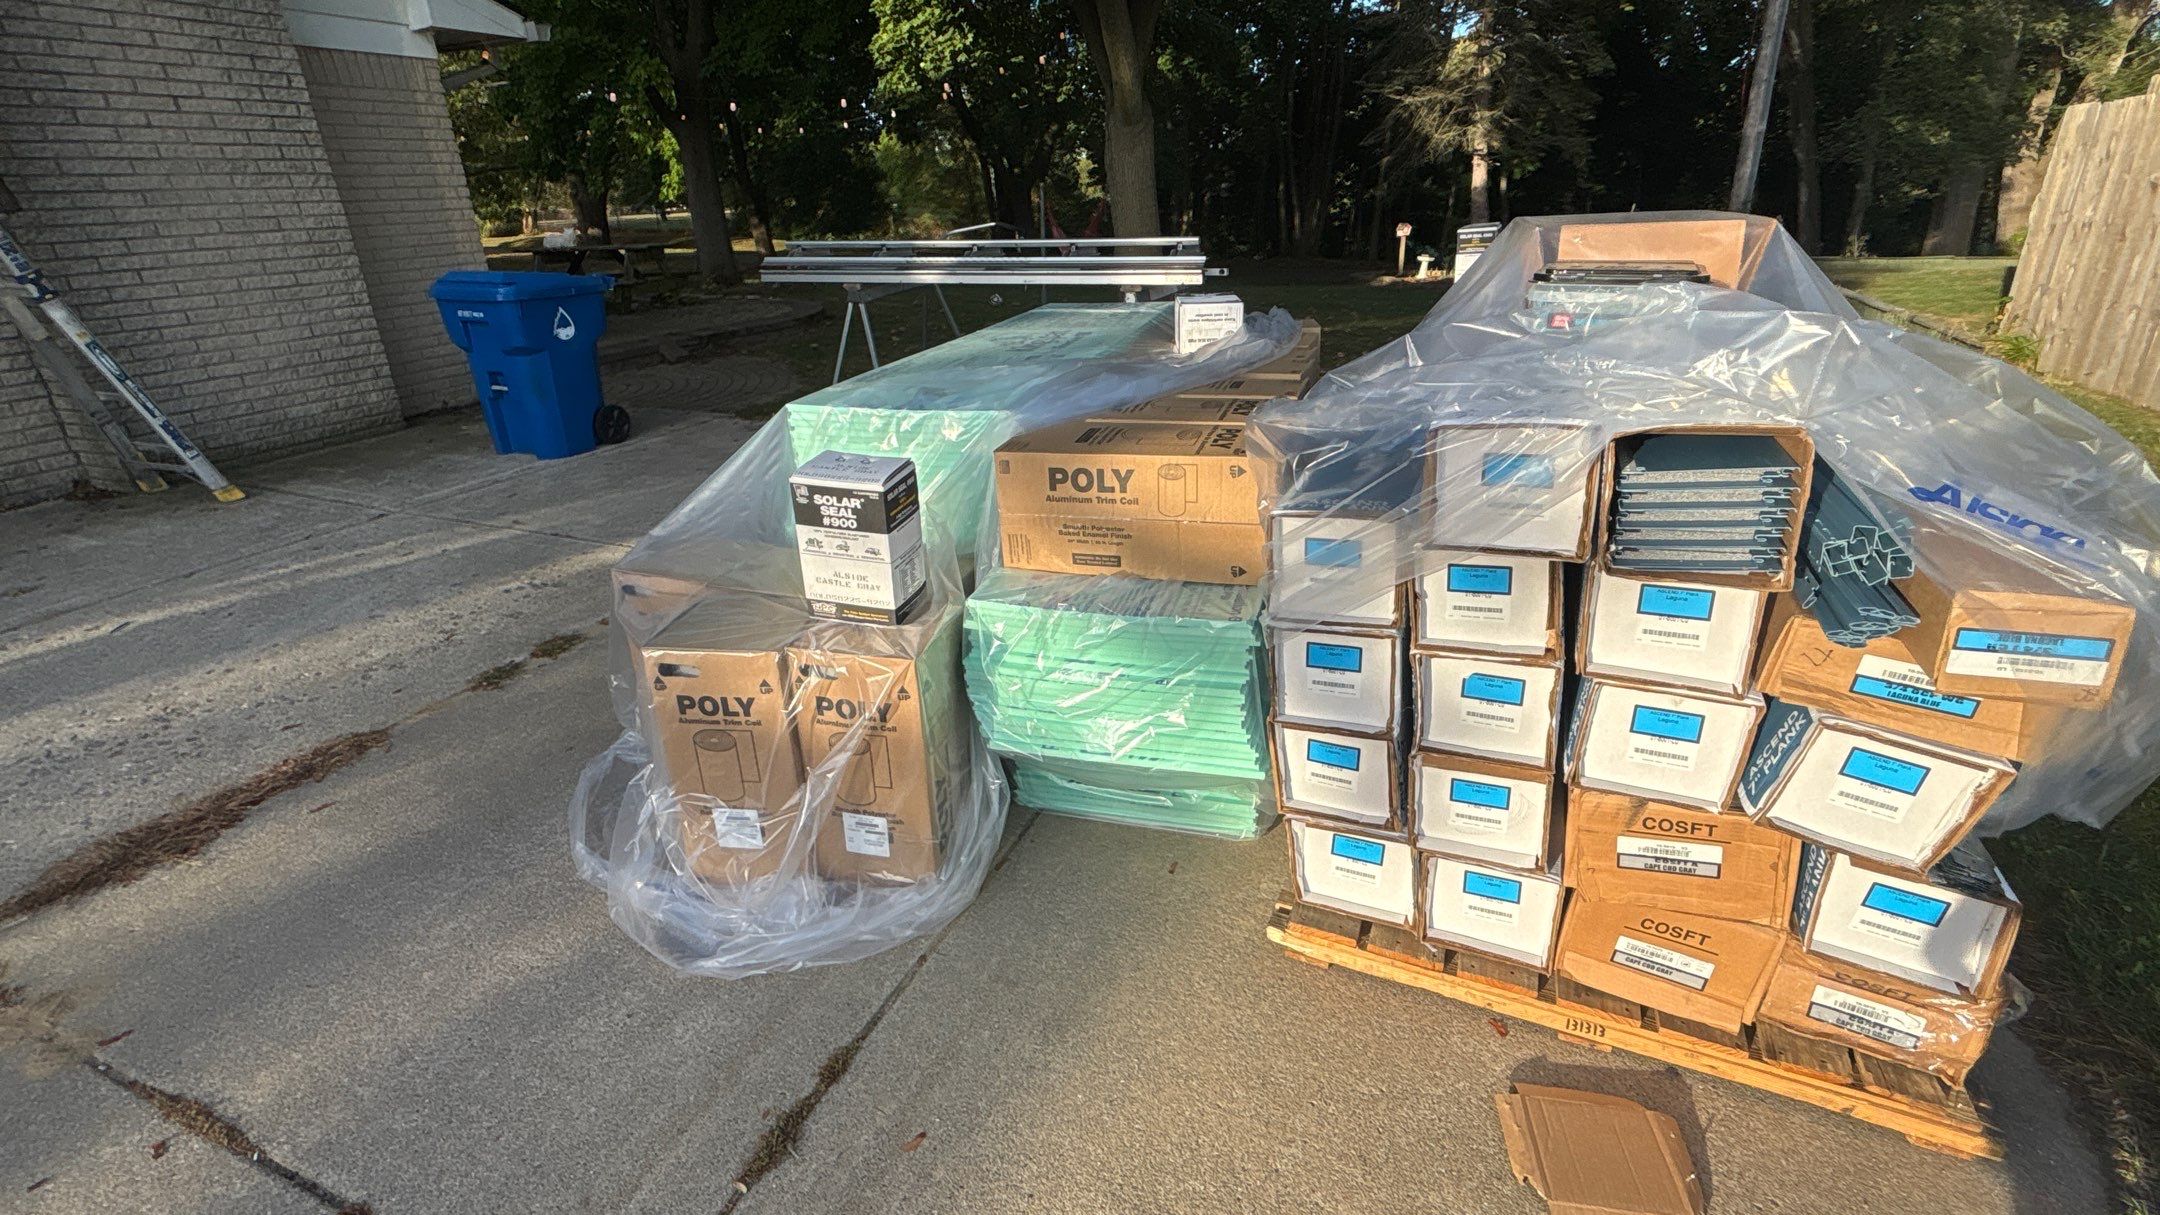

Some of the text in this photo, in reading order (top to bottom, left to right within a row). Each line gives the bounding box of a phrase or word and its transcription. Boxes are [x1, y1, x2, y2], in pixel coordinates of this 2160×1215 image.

[1210, 428, 1243, 449] POLY
[1230, 464, 1237, 479] UP
[1048, 467, 1135, 493] POLY
[1046, 494, 1139, 506] Aluminum Trim Coil
[820, 505, 857, 519] SEAL
[822, 516, 858, 529] #900
[833, 571, 869, 582] ALSIDE
[1230, 565, 1238, 578] UP
[815, 576, 881, 592] CASTLE GRAY
[760, 687, 774, 695] UP
[897, 693, 911, 701] UP
[676, 694, 756, 718] POLY
[1886, 690, 1942, 709] LAGUNA BLUE
[678, 717, 722, 726] Aluminum
[723, 718, 743, 726] Trim
[880, 724, 898, 733] Coil
[1749, 711, 1799, 781] ASCEND
[1763, 713, 1807, 775] PLANK
[1874, 763, 1899, 773] Laguna
[1642, 816, 1719, 837] COSFT
[1644, 863, 1698, 874] CAPE COD GRAY
[1799, 844, 1817, 914] ASCEND
[1640, 918, 1712, 946] COSFT
[1625, 956, 1674, 976] CAPE COD GRAY
[1835, 971, 1917, 999] COSFT
[1566, 1018, 1606, 1038] 131313
